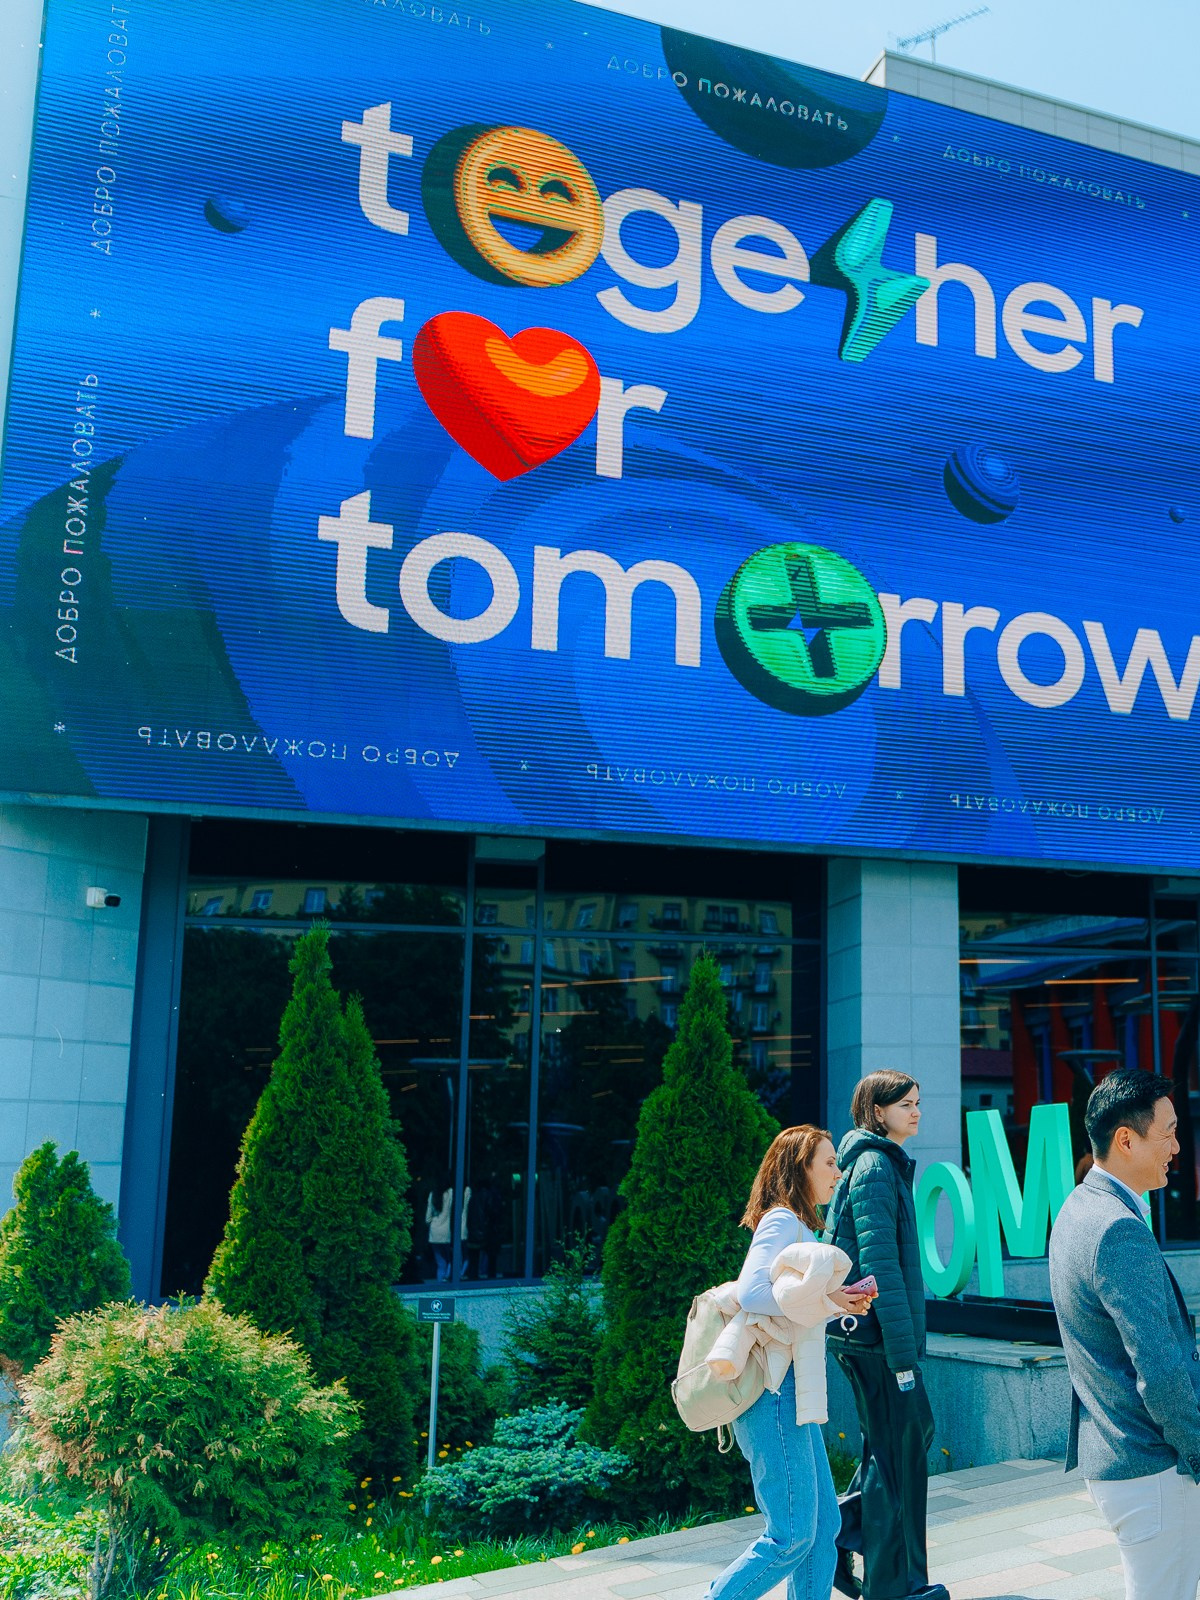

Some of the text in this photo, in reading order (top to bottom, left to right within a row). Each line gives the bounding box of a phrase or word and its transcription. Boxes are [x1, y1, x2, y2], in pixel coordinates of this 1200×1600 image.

[606, 55, 848, 131] ДОБРО ПОЖАЛОВАТЬ
[91, 0, 131, 256] ДОБРО ПОЖАЛОВАТ
[943, 145, 1146, 209] ДОБРО ПОЖАЛОВАТЬ
[55, 374, 98, 664] ДОБРО ПОЖАЛОВАТЬ
[137, 726, 460, 769] ДОБРО ПОЖАЛОВАТЬ
[586, 763, 847, 799] ДОБРО ПОЖАЛОВАТЬ
[950, 793, 1165, 824] ДОБРО ПОЖАЛОВАТЬ
